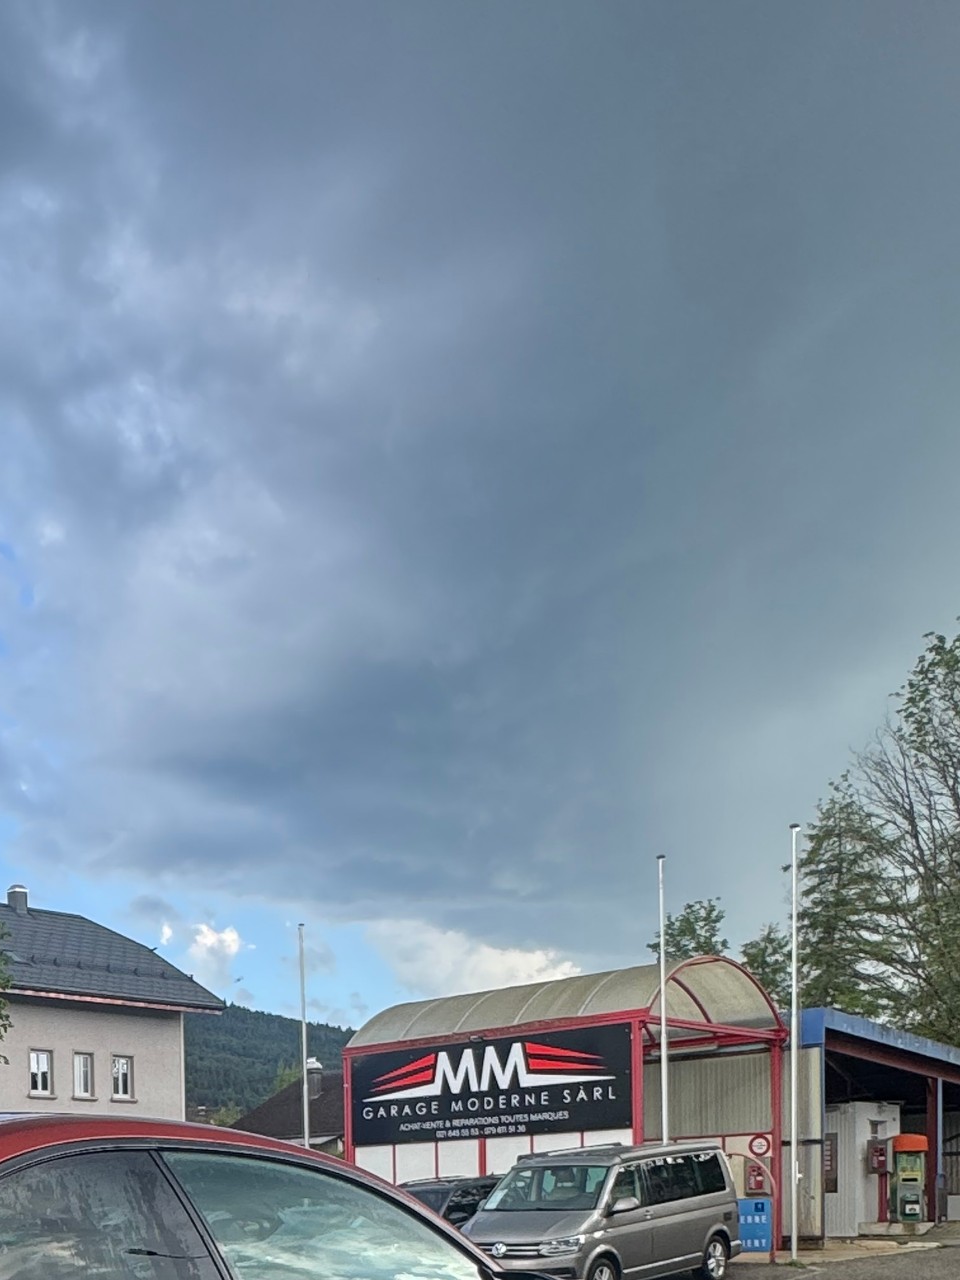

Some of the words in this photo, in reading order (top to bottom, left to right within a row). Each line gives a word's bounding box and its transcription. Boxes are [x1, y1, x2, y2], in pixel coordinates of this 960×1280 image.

[362, 1101, 440, 1120] GARAGE
[450, 1092, 550, 1112] MODERNE
[500, 1113, 529, 1124] TOUTES
[529, 1110, 570, 1121] MARQUES
